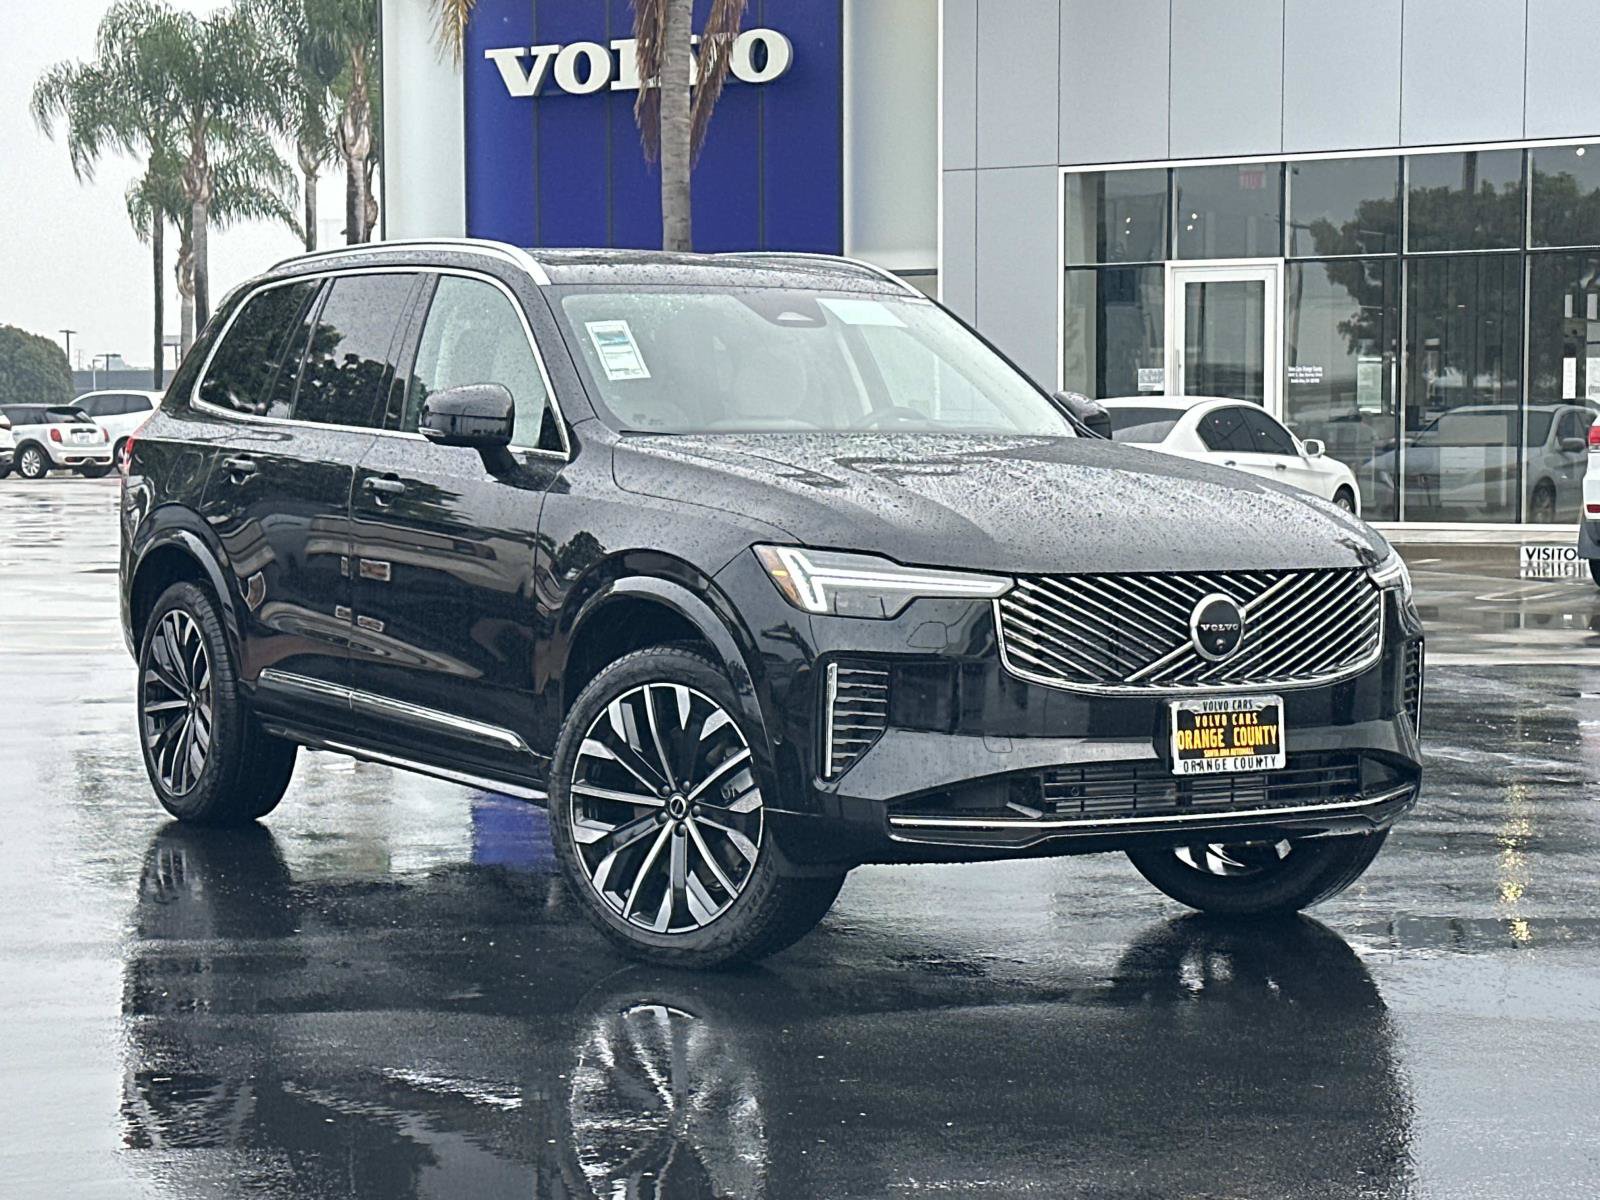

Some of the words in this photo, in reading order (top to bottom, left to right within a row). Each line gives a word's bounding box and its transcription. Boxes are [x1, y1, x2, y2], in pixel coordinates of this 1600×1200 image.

[485, 28, 793, 97] VOLO
[1526, 548, 1577, 560] VISITO
[1200, 623, 1239, 631] VOLVO
[1203, 701, 1229, 712] VOLVO
[1233, 699, 1253, 710] CARS
[1195, 713, 1227, 727] VOLVO
[1232, 713, 1257, 725] CARS
[1177, 728, 1225, 749] ORANGE
[1233, 725, 1277, 747] COUNTY
[1183, 758, 1227, 773] ORANGE
[1234, 756, 1276, 769] COUNTY
